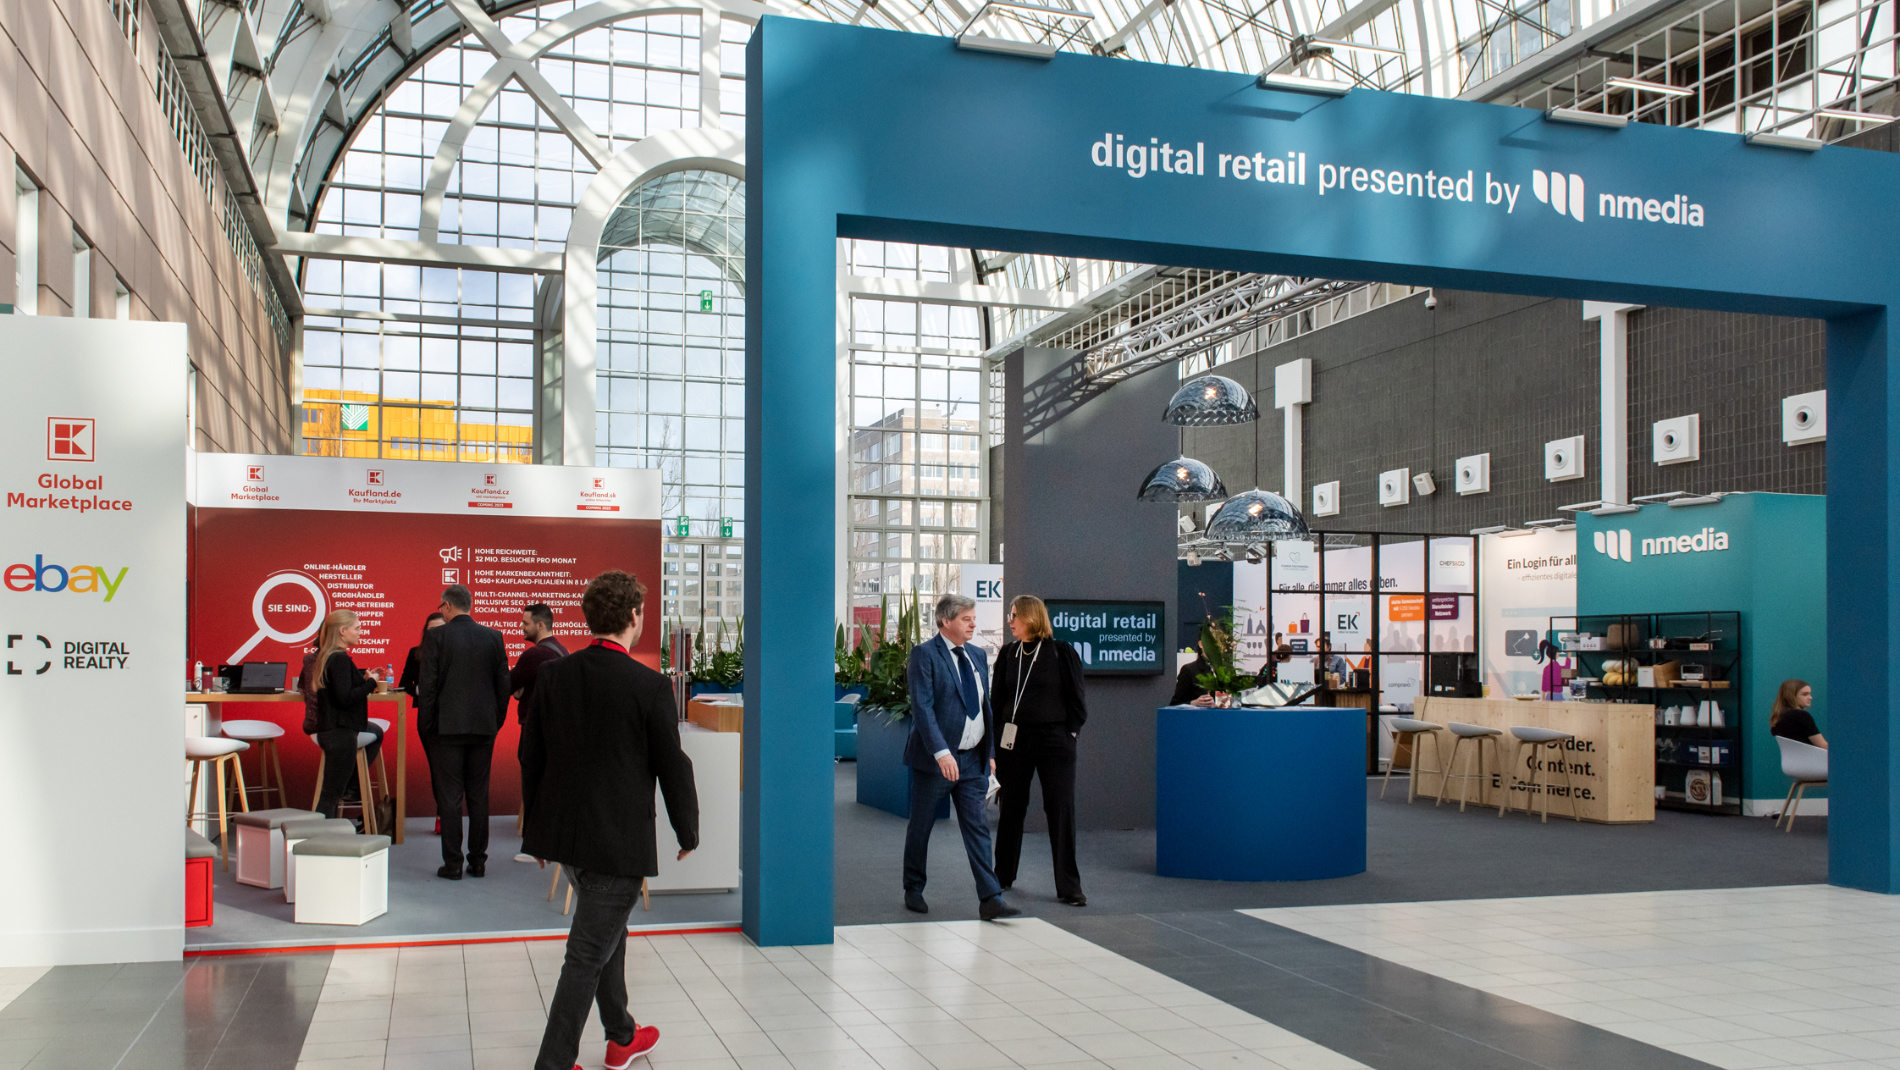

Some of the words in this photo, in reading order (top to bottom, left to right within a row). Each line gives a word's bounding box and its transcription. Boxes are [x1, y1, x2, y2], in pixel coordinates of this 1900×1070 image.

[1091, 133, 1204, 178] digital
[1218, 152, 1306, 186] retail
[1318, 162, 1474, 202] presented
[1485, 172, 1520, 214] by
[1599, 192, 1704, 228] nmedia
[38, 474, 102, 490] Global
[231, 493, 280, 502] Marketplace
[243, 486, 268, 494] Global
[348, 489, 402, 498] Kaufland.de
[7, 492, 132, 514] Marketplace
[1642, 528, 1729, 556] nmedia
[1507, 559, 1521, 569] Ein
[1523, 557, 1547, 570] Login
[1549, 556, 1563, 566] für
[1565, 554, 1576, 565] all
[4, 554, 130, 602] ebay
[1324, 582, 1346, 592] mmer
[1348, 578, 1367, 590] alles
[976, 580, 1001, 598] EK
[285, 604, 311, 613] SIND:
[1053, 612, 1106, 632] digital
[1113, 613, 1156, 629] retail
[1338, 614, 1358, 630] EK
[1099, 633, 1143, 643] presented
[1145, 633, 1155, 645] by
[64, 642, 130, 654] DIGITAL
[1099, 647, 1156, 662] nmedia
[64, 656, 128, 669] REALTY
